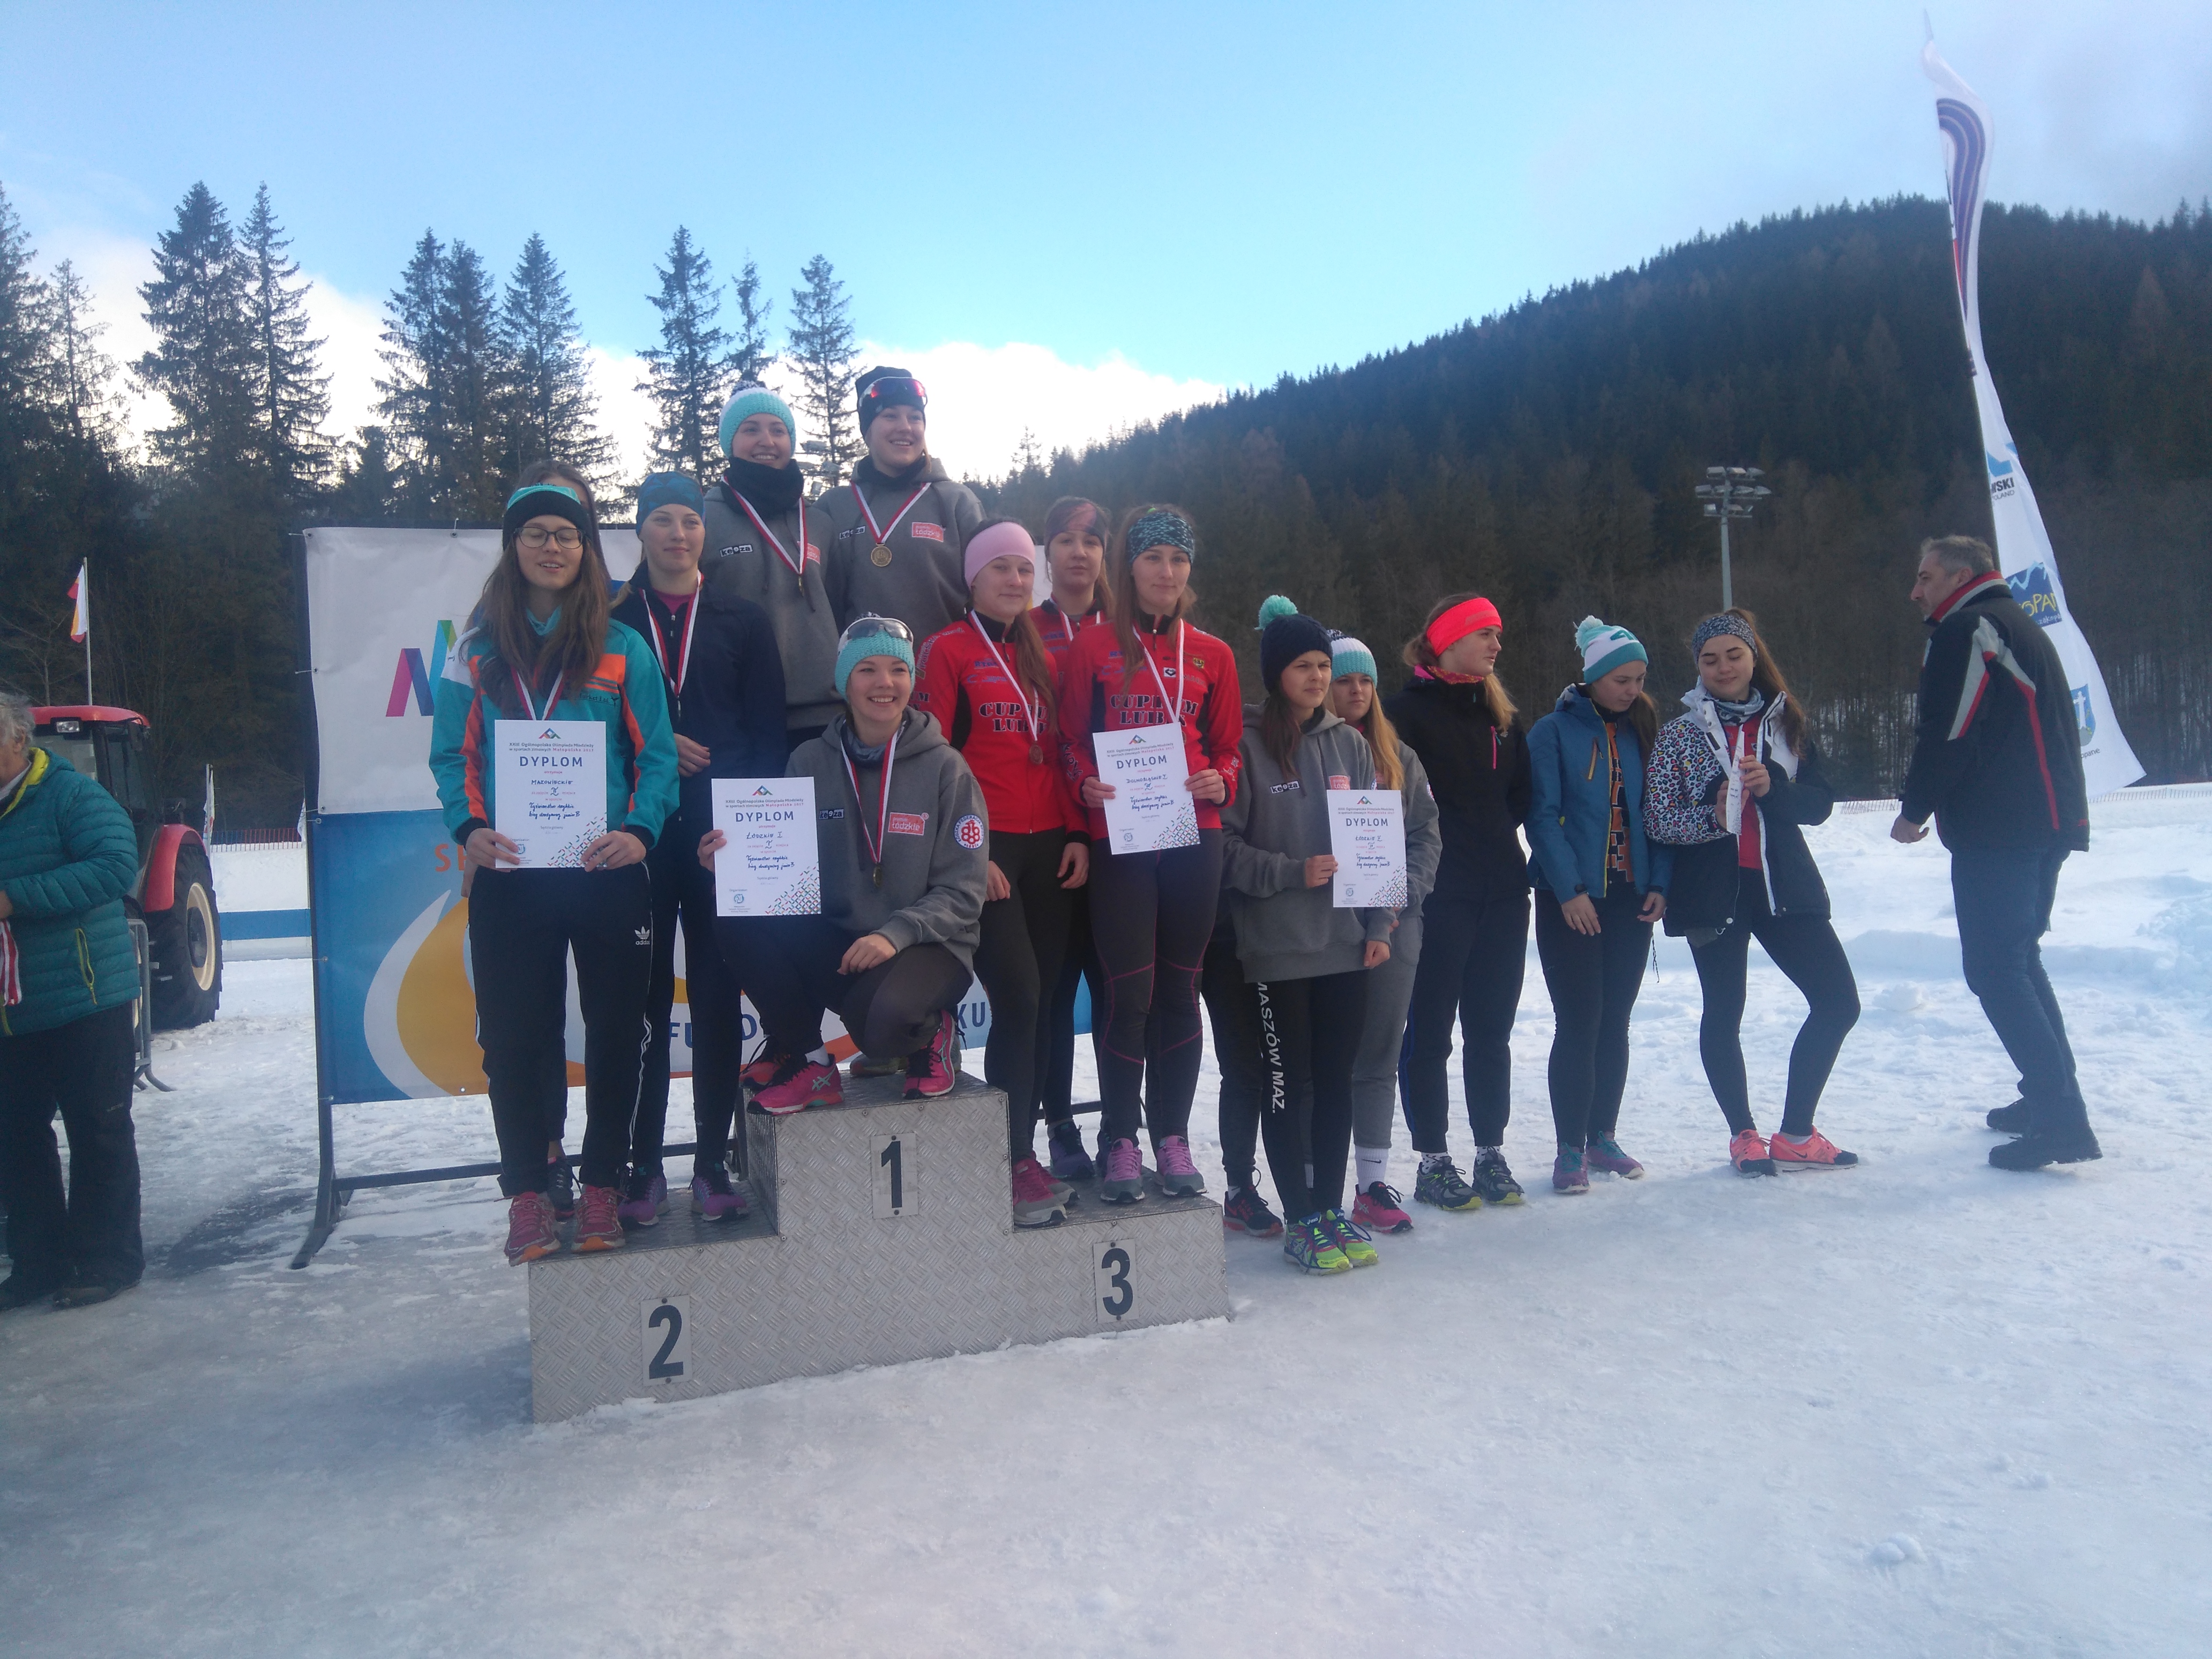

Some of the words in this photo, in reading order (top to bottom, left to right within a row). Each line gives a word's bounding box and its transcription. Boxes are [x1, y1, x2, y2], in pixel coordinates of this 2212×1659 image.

[2081, 748, 2101, 759] opane
[520, 756, 582, 767] DYPLOM
[1117, 754, 1167, 769] DYPLOM
[1271, 781, 1299, 793] keeza
[736, 811, 794, 822] DYPLOM
[819, 810, 843, 819] keeza
[1346, 818, 1388, 826] DYPLOM
[1272, 1071, 1285, 1114] MAZ.
[880, 1139, 903, 1209] 1
[1100, 1247, 1134, 1317] 3
[647, 1305, 685, 1381] 2
